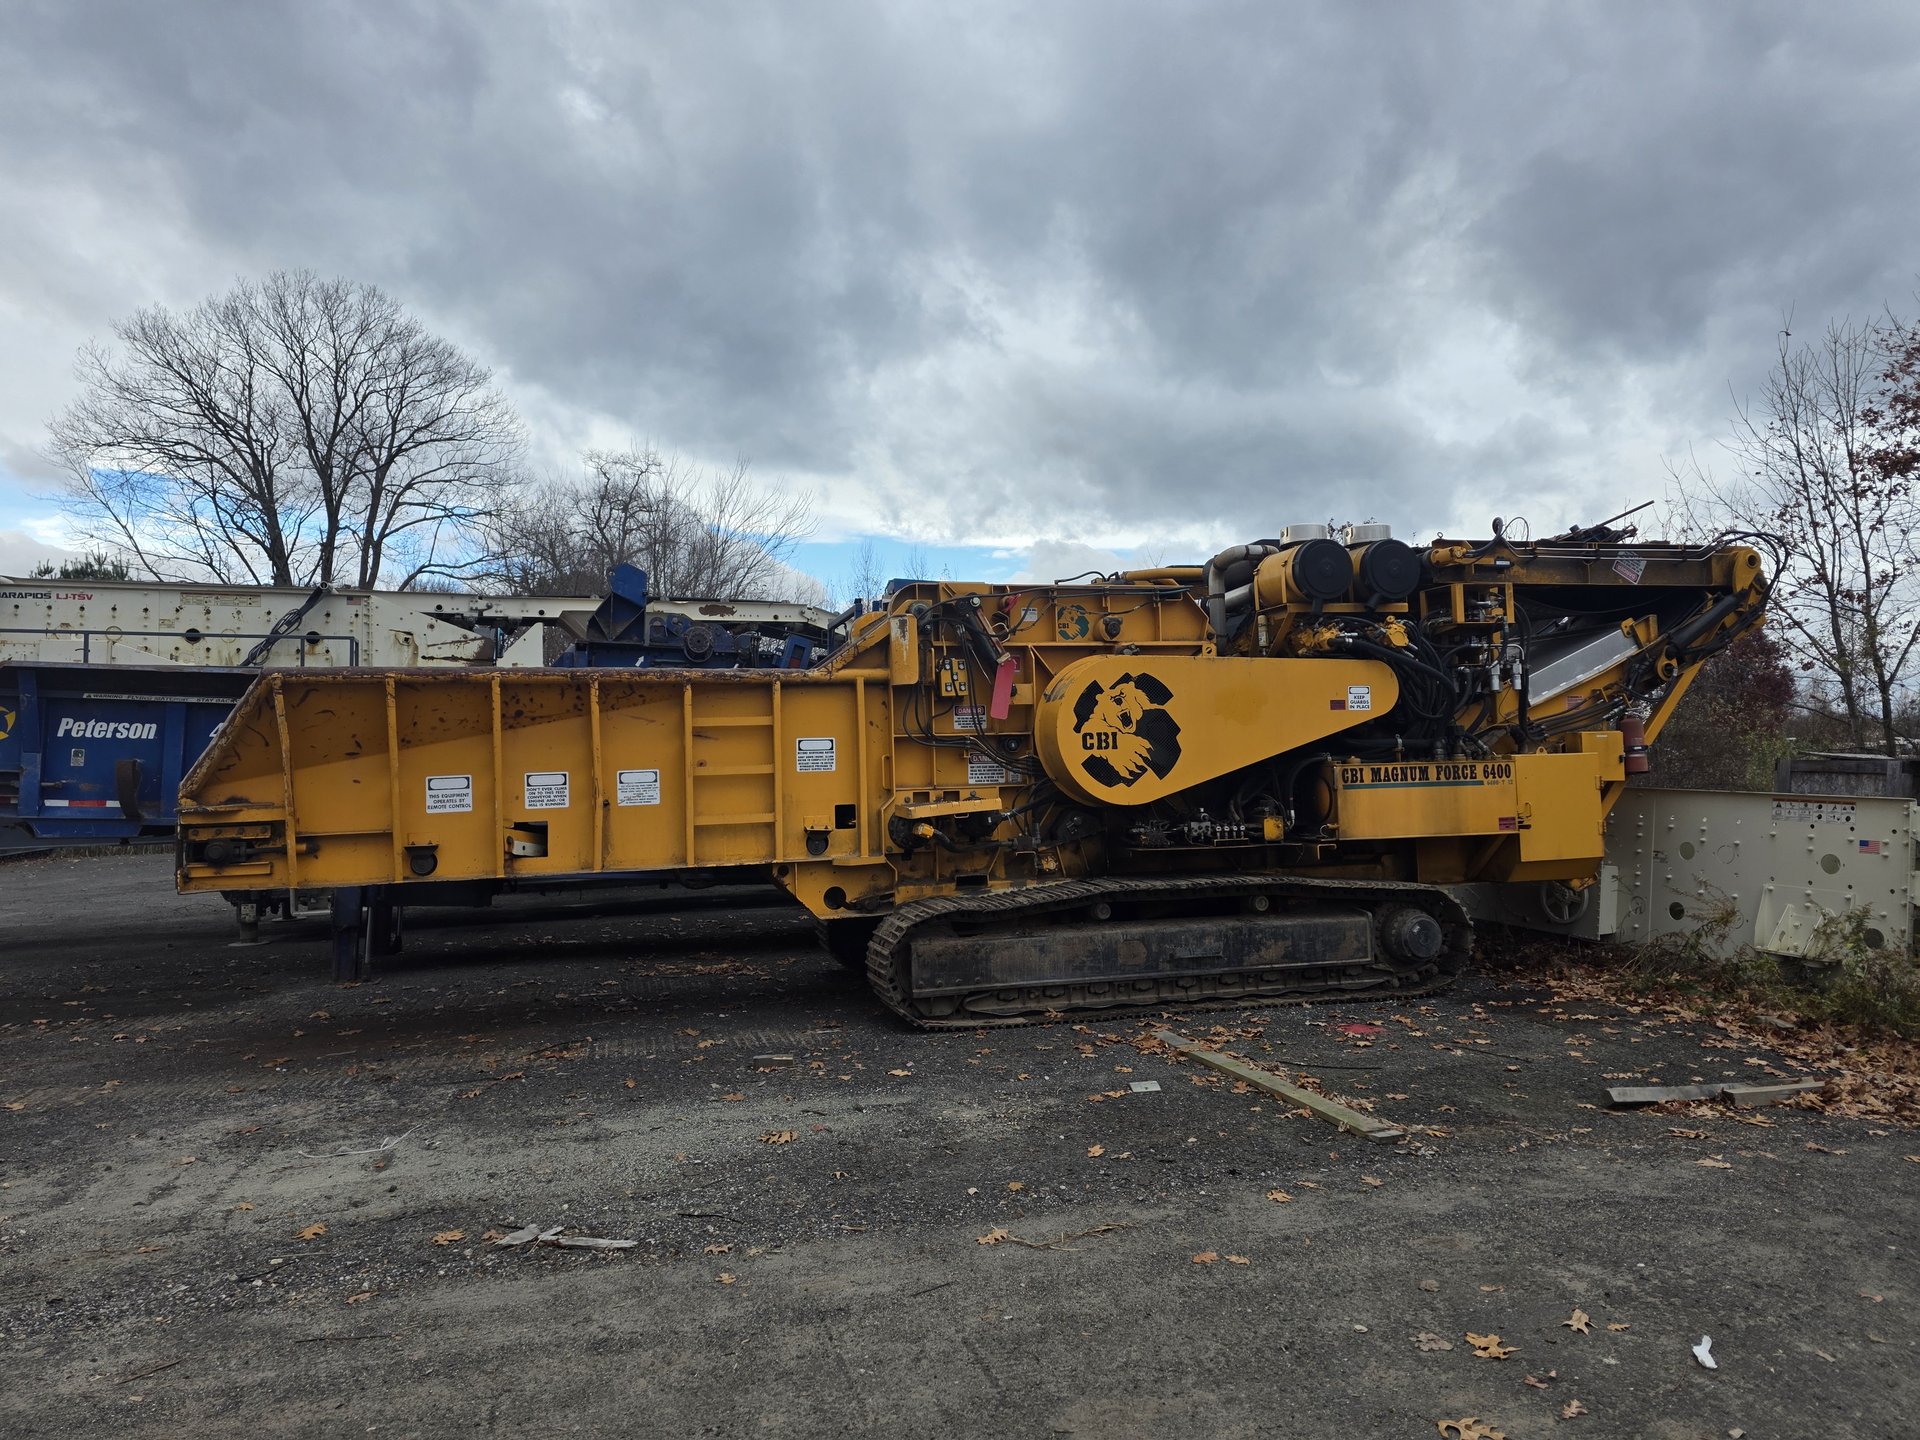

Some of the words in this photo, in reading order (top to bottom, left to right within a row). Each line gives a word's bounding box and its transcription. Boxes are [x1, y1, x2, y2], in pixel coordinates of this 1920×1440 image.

[57, 717, 157, 739] Peterson
[1082, 731, 1118, 750] CBI
[1341, 767, 1364, 784] CBI
[1370, 765, 1430, 782] MAGNUM
[1435, 764, 1477, 780] FORCE
[1483, 763, 1512, 779] 6400
